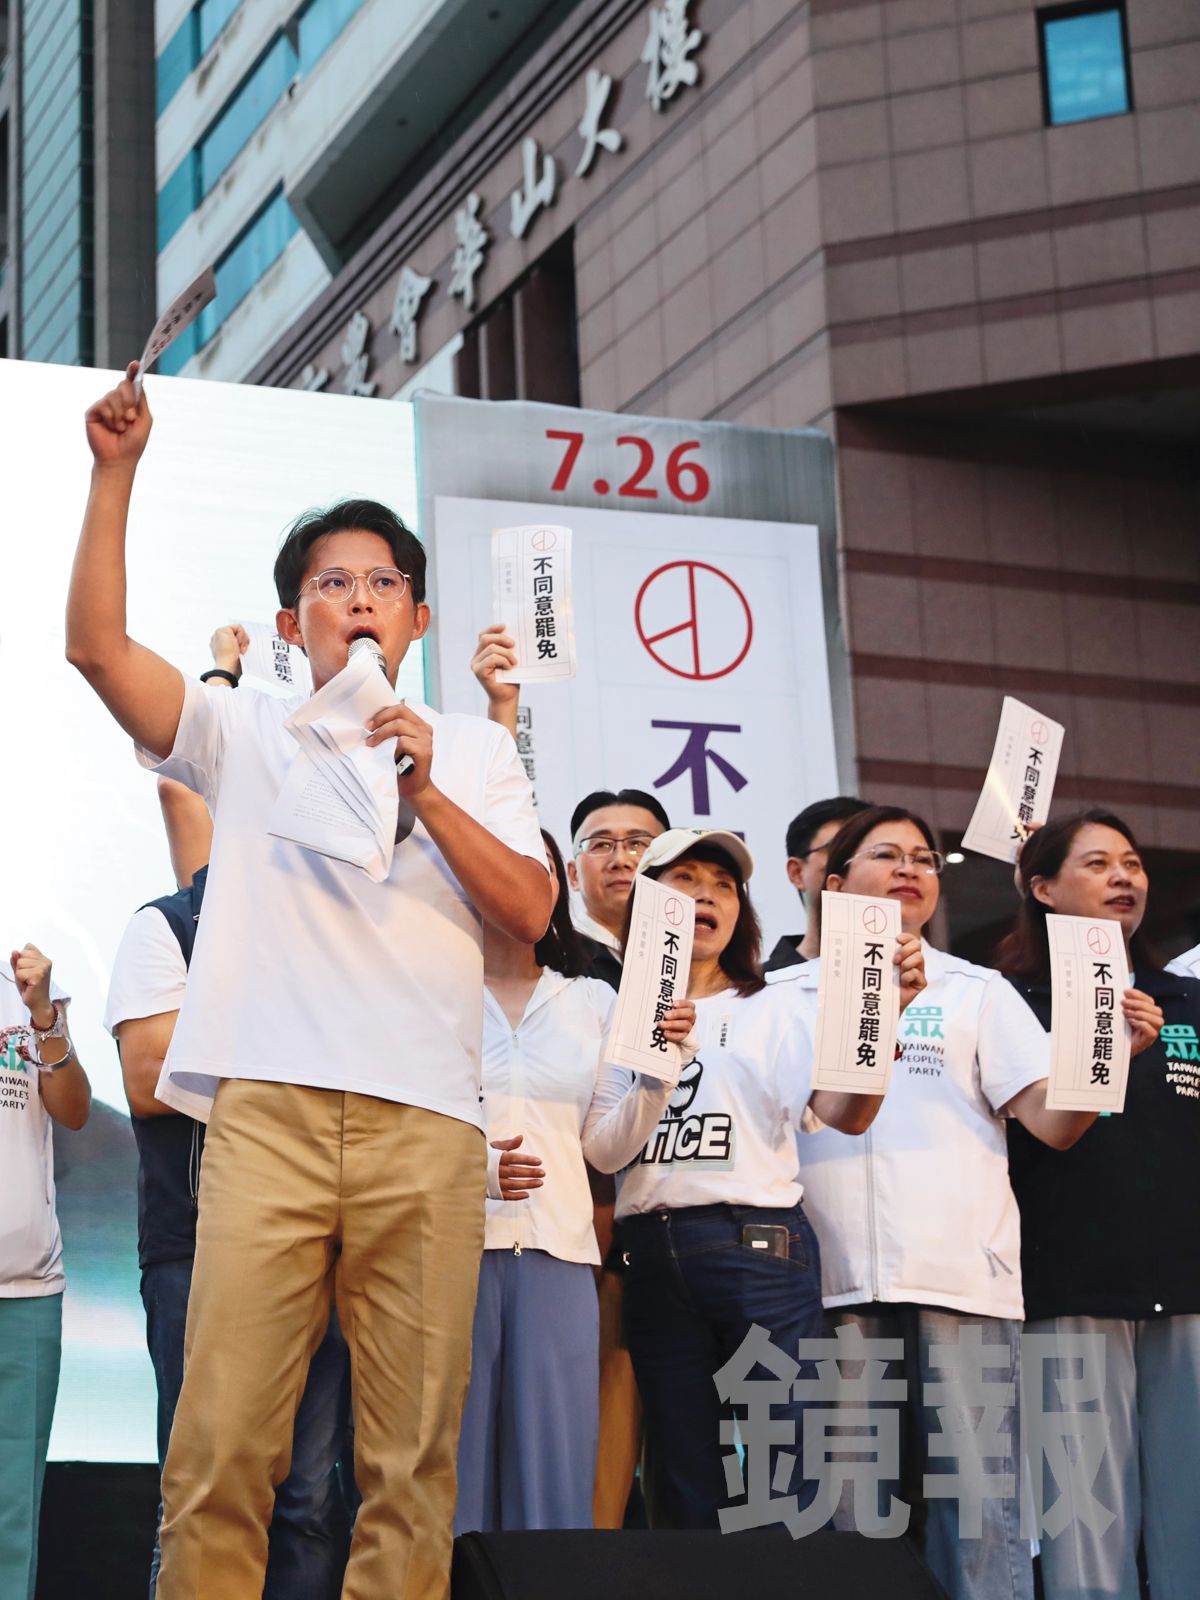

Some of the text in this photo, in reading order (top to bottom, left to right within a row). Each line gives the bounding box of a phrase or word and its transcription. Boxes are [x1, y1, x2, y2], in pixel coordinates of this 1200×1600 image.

[545, 429, 711, 504] 7.26
[534, 556, 558, 660] 不同意罷免
[517, 706, 538, 806] 同意罷
[650, 930, 680, 1053] 不同意罷免
[855, 942, 884, 1068] 不同意罷免
[1090, 962, 1115, 1085] 不同意罷免
[909, 1066, 942, 1077] PARTY
[638, 1113, 732, 1166] TICE
